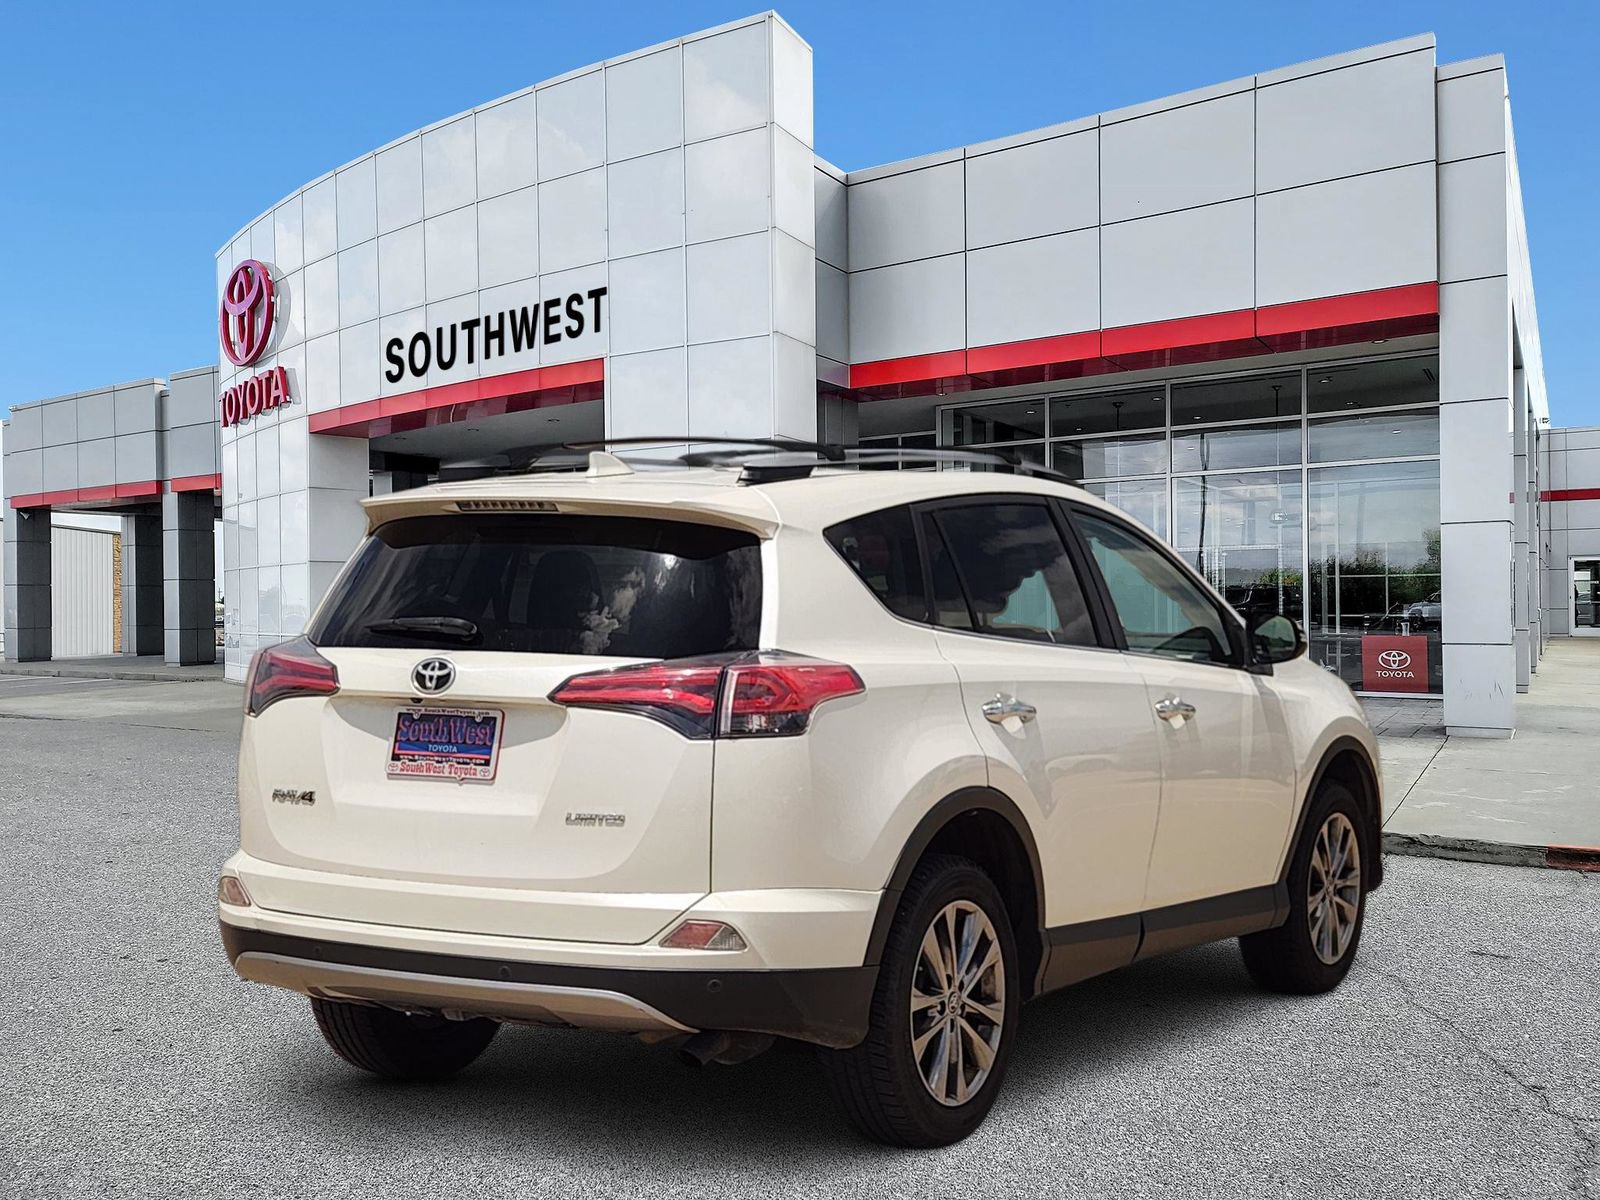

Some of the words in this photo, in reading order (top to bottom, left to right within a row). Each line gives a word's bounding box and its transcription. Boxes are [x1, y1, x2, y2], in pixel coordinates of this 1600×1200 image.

[384, 286, 608, 384] SOUTHWEST
[219, 366, 291, 428] TOYOTA
[1375, 670, 1415, 678] TOYOTA
[428, 744, 458, 753] TOYOTA
[447, 764, 478, 778] Toyota
